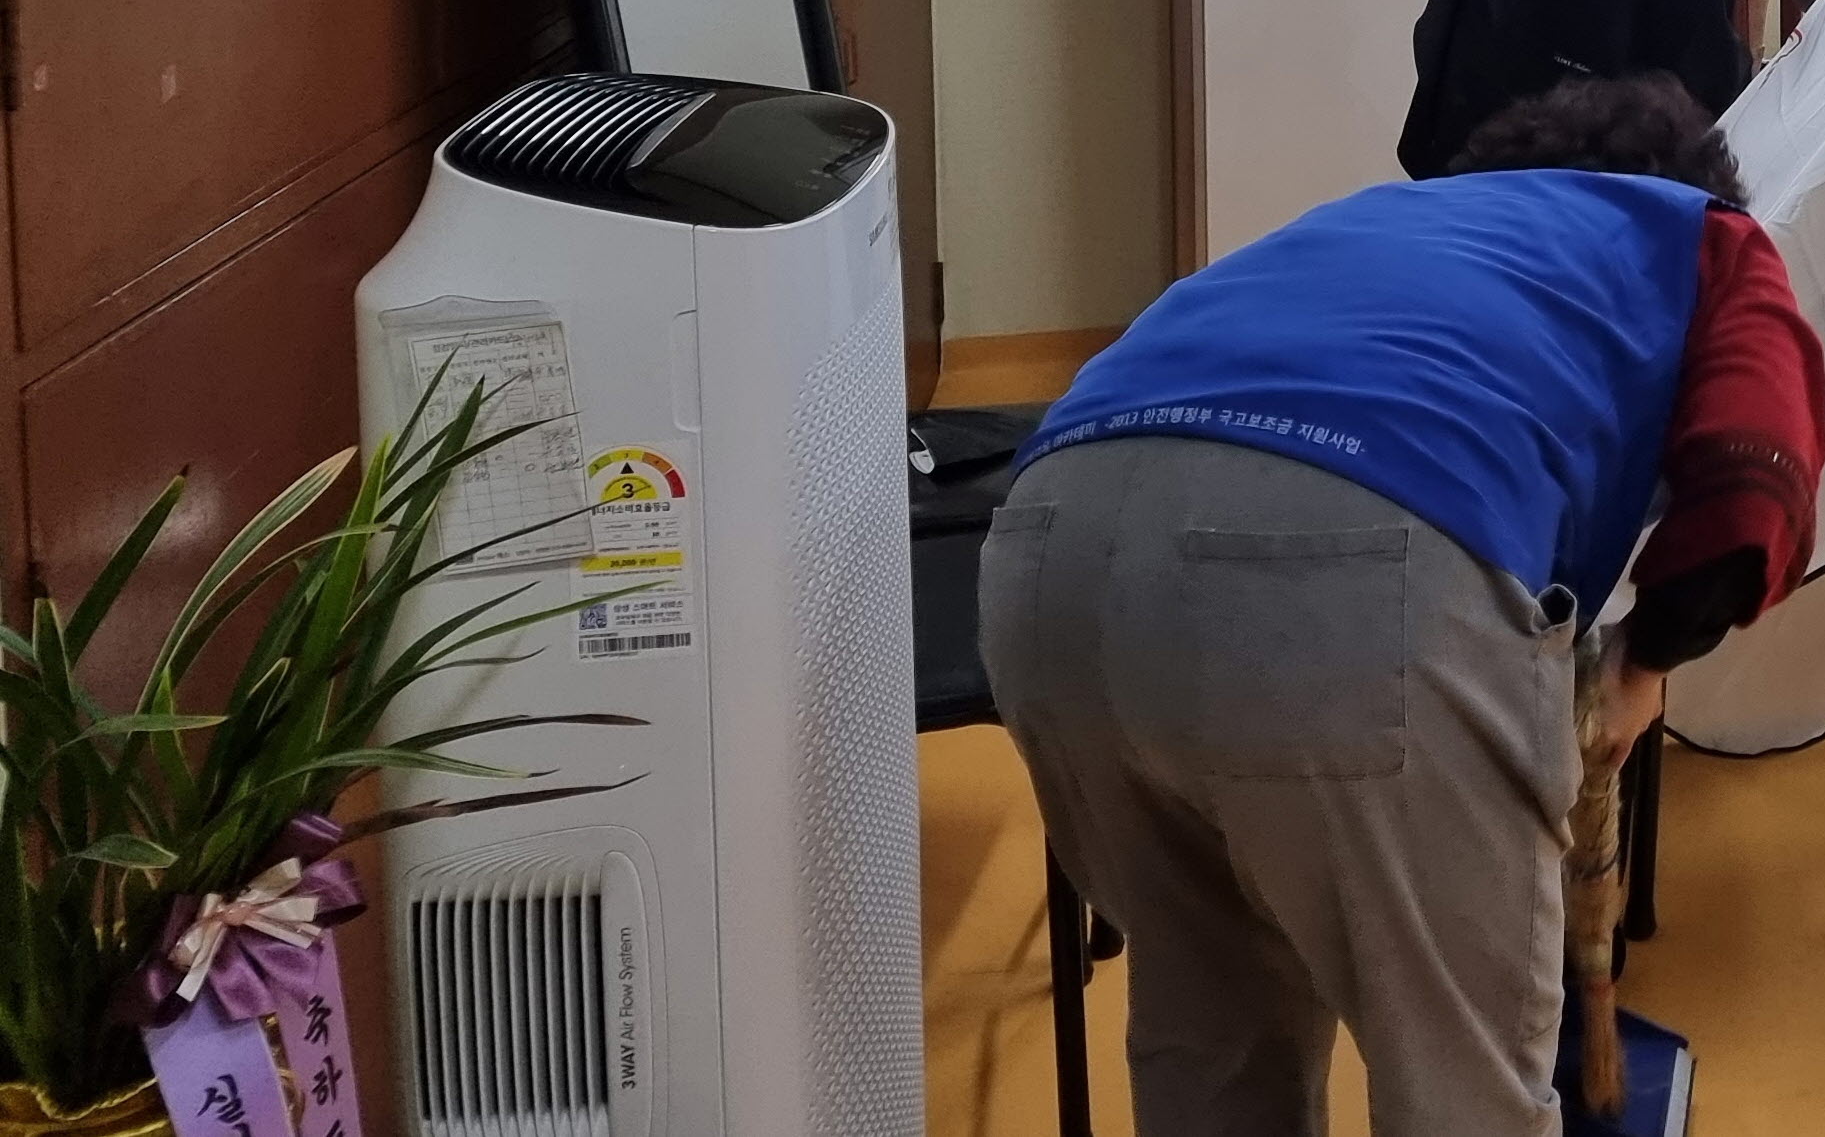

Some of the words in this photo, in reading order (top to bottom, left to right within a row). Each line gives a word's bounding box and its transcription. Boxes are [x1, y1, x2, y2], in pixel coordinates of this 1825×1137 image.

[1219, 409, 1294, 435] 국고보조금
[621, 483, 634, 499] 3
[617, 927, 635, 980] System
[618, 984, 634, 1018] Flow
[620, 1022, 635, 1040] Air
[620, 1044, 636, 1089] 3WAY
